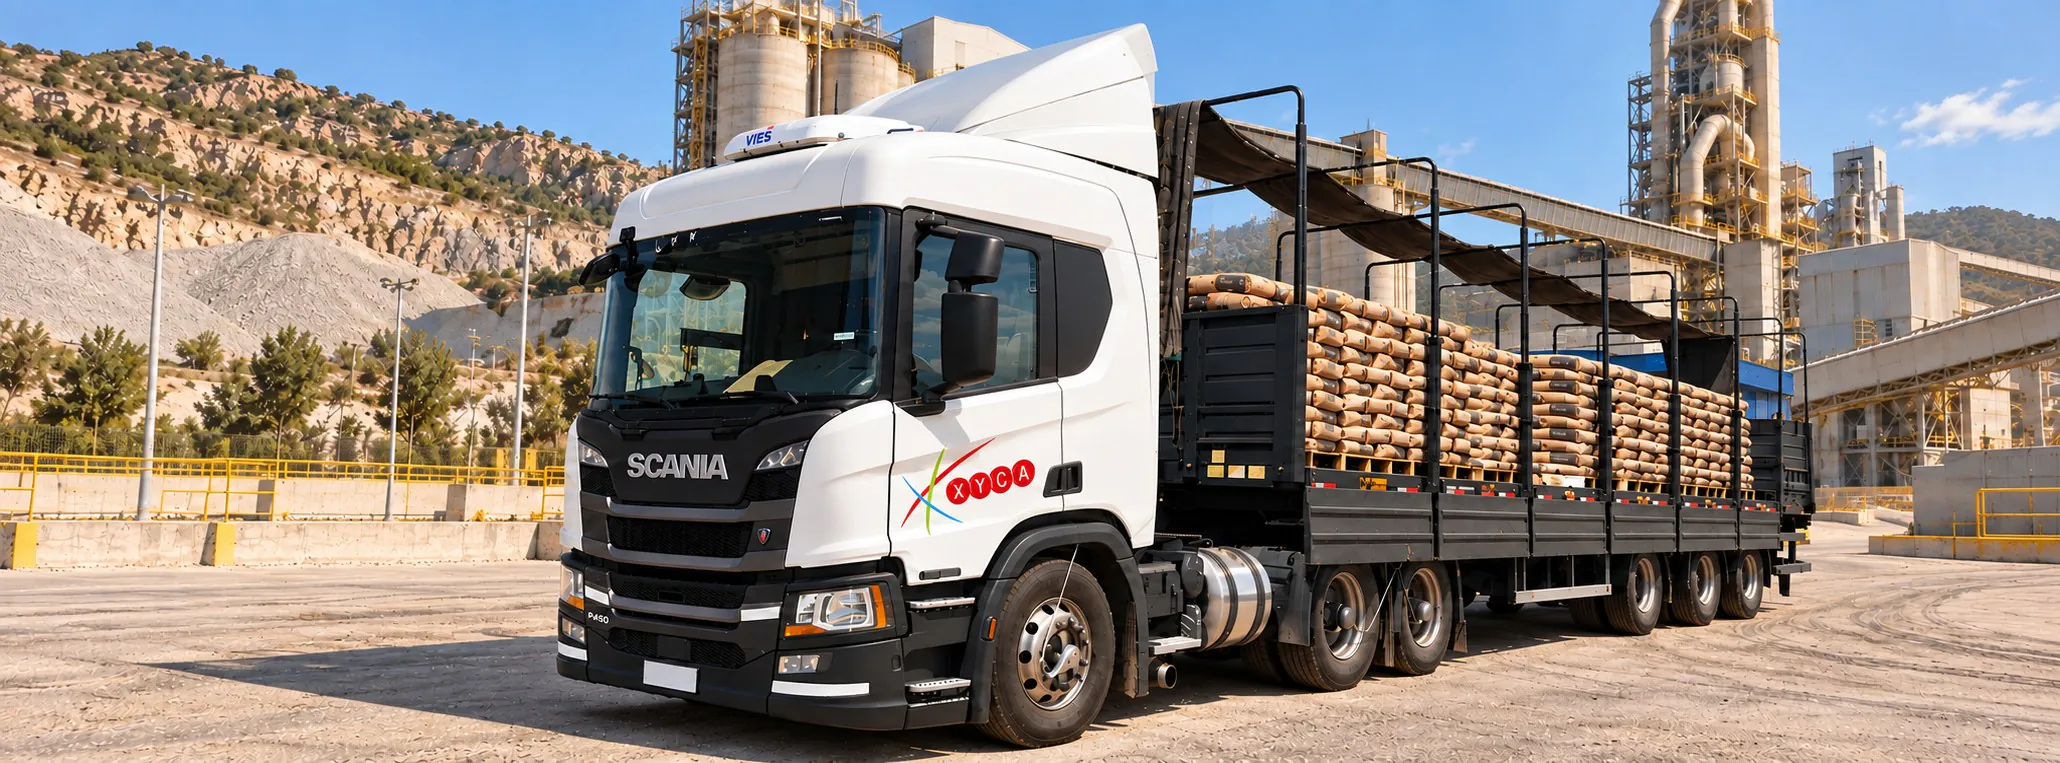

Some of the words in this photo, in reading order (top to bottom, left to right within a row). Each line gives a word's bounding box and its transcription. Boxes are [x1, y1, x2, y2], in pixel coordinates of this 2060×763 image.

[746, 130, 772, 146] VIES
[626, 452, 729, 480] SCANIA
[951, 463, 1031, 501] XYCA
